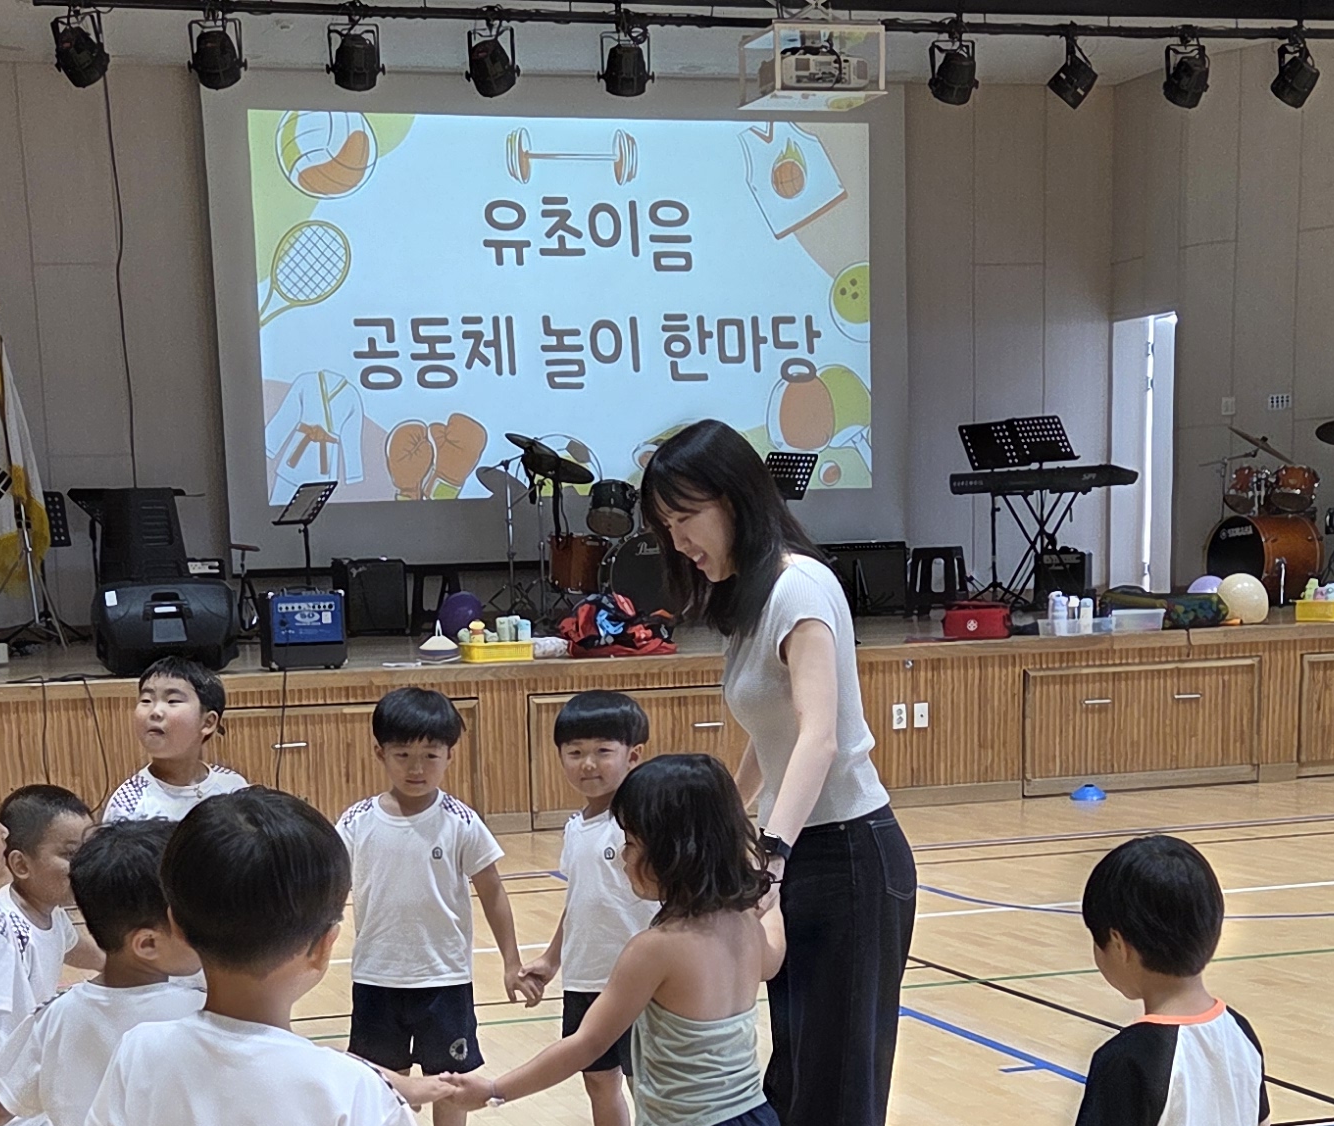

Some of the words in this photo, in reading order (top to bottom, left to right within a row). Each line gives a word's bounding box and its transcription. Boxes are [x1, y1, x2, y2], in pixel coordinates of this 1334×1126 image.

[482, 195, 693, 273] 유초이음
[352, 314, 517, 391] 공동체
[539, 314, 641, 390] 놀이
[661, 312, 822, 384] 한마당
